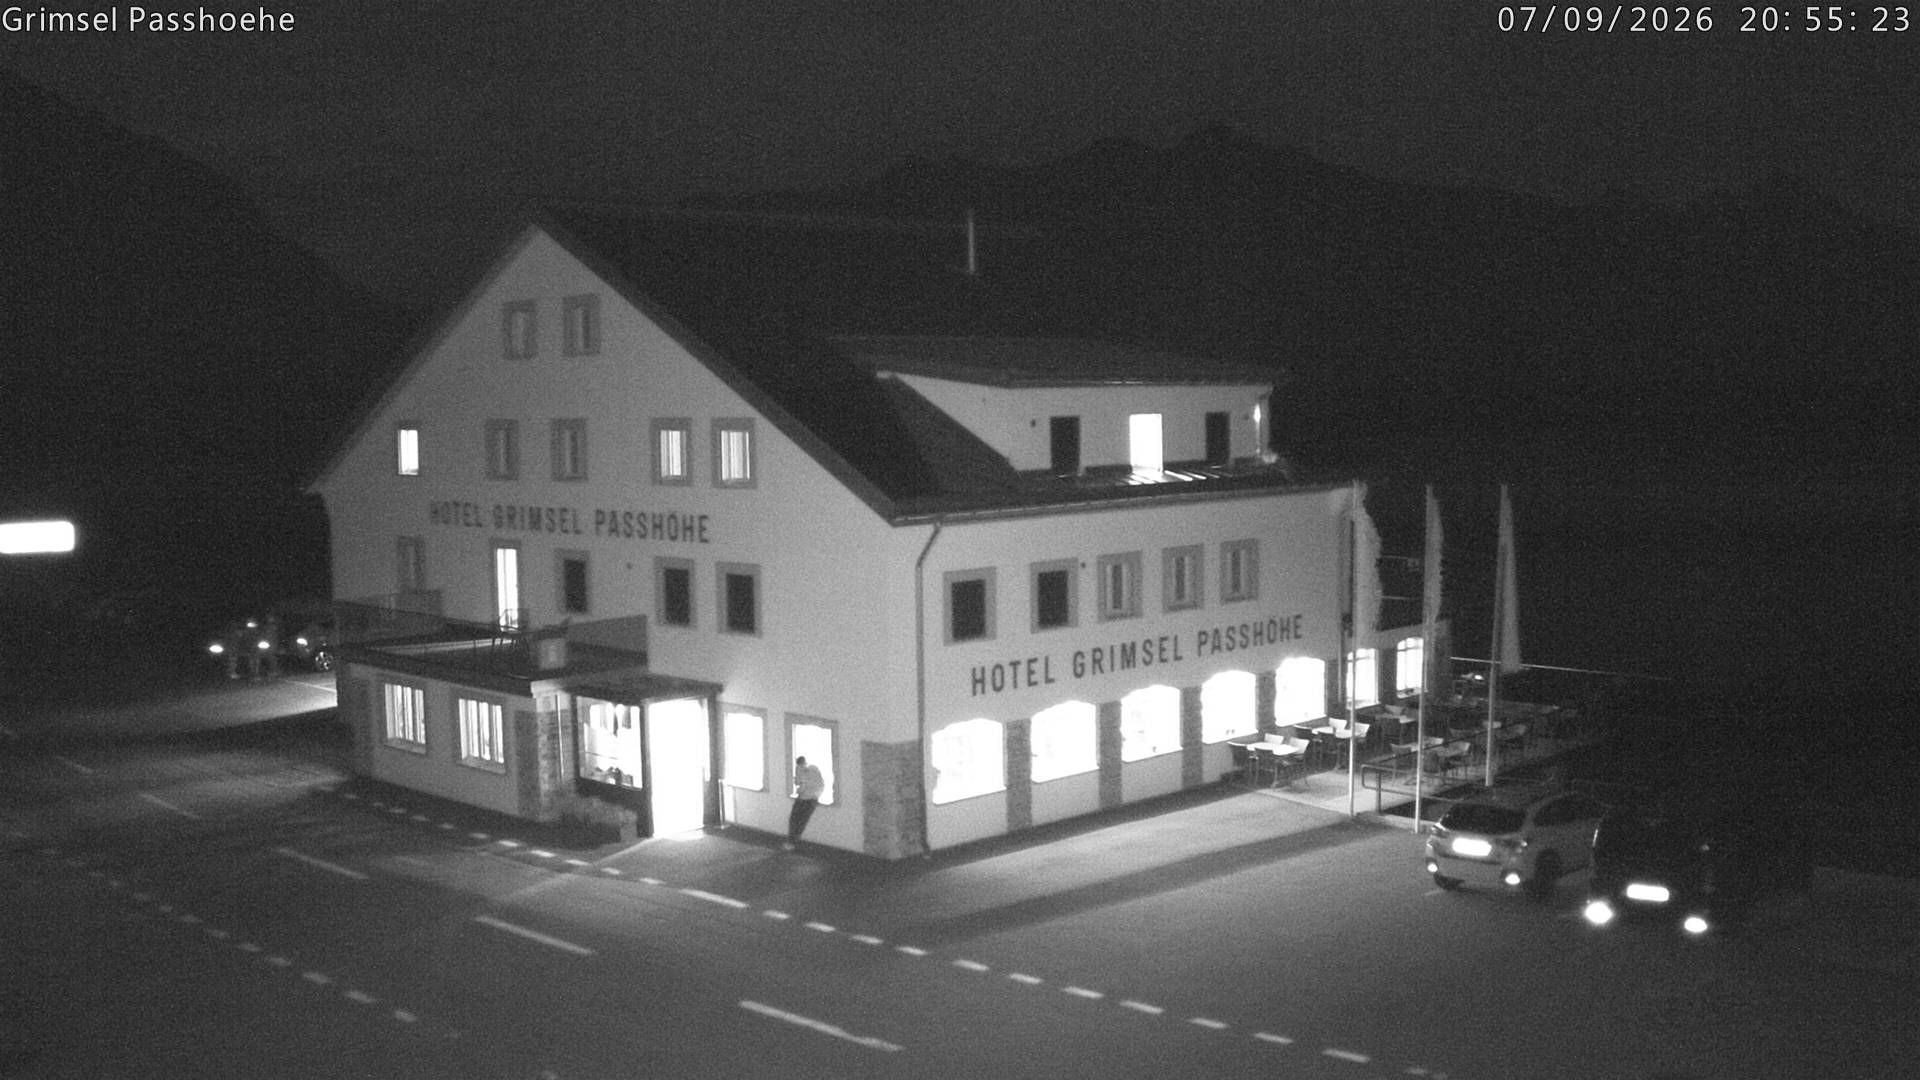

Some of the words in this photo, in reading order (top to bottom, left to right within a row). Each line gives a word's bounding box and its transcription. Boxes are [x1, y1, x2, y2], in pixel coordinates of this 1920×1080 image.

[492, 503, 582, 535] GRIMSEL
[971, 655, 1056, 696] HOTEL
[1072, 634, 1184, 679] GRIMSEL
